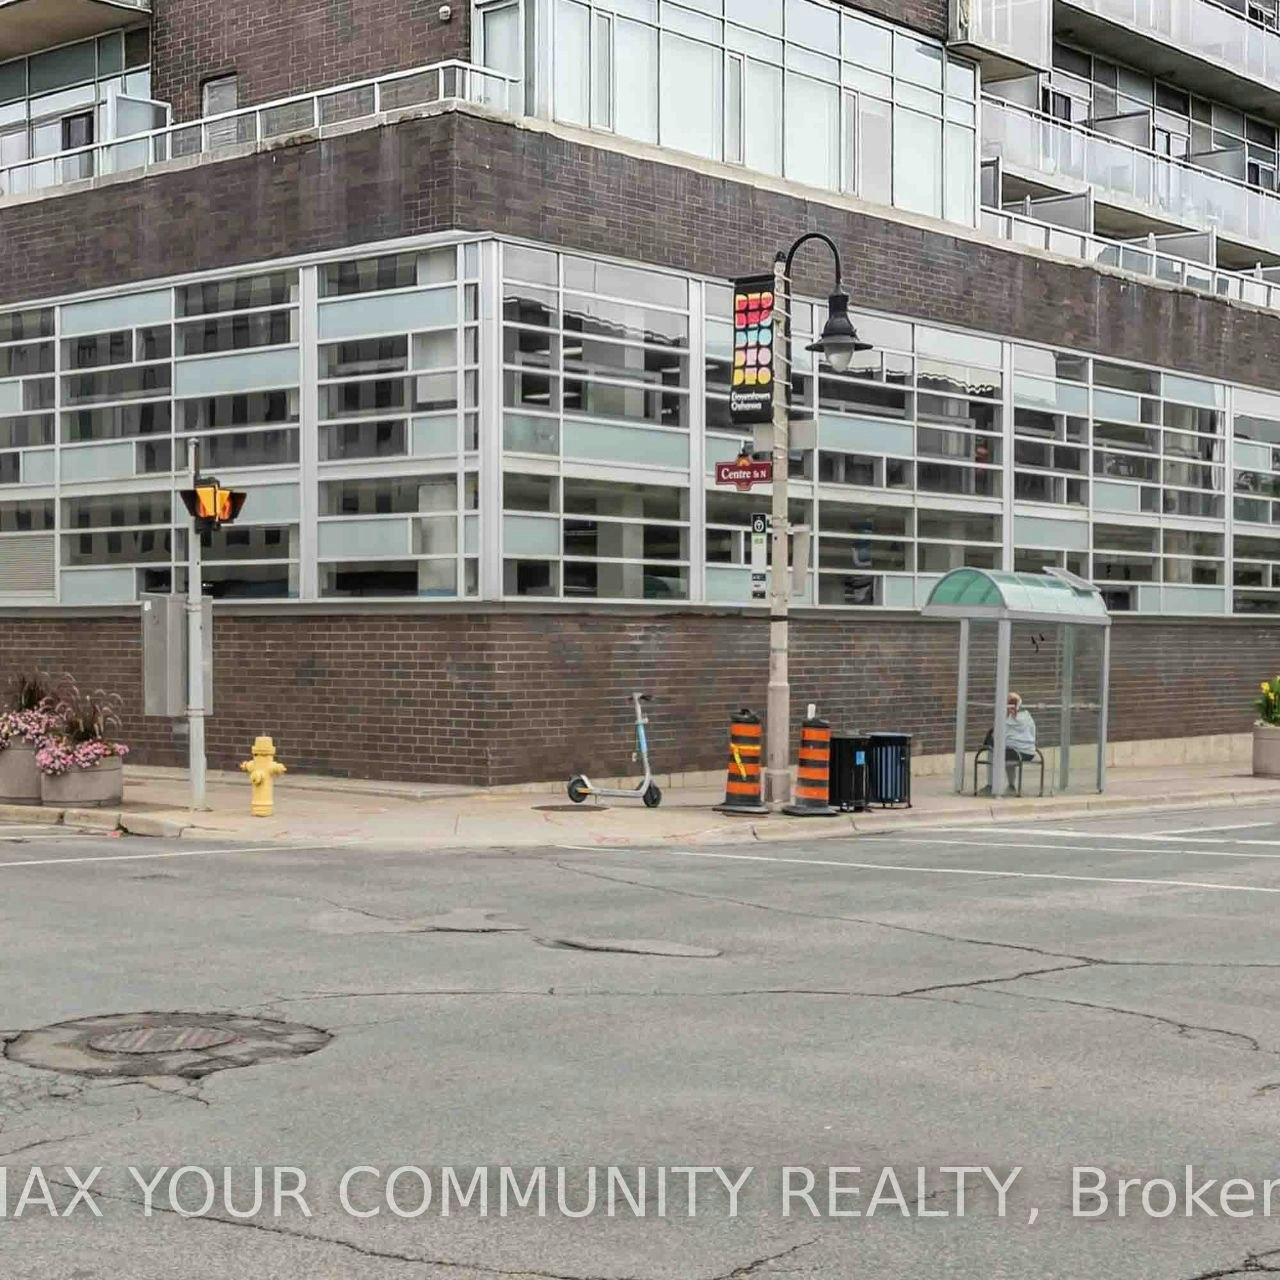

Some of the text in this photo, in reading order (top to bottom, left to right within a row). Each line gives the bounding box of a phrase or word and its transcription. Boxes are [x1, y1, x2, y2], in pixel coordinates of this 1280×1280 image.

[731, 391, 771, 402] Downtown
[730, 401, 762, 412] Oshawa
[721, 467, 752, 480] Centre
[760, 470, 767, 479] N
